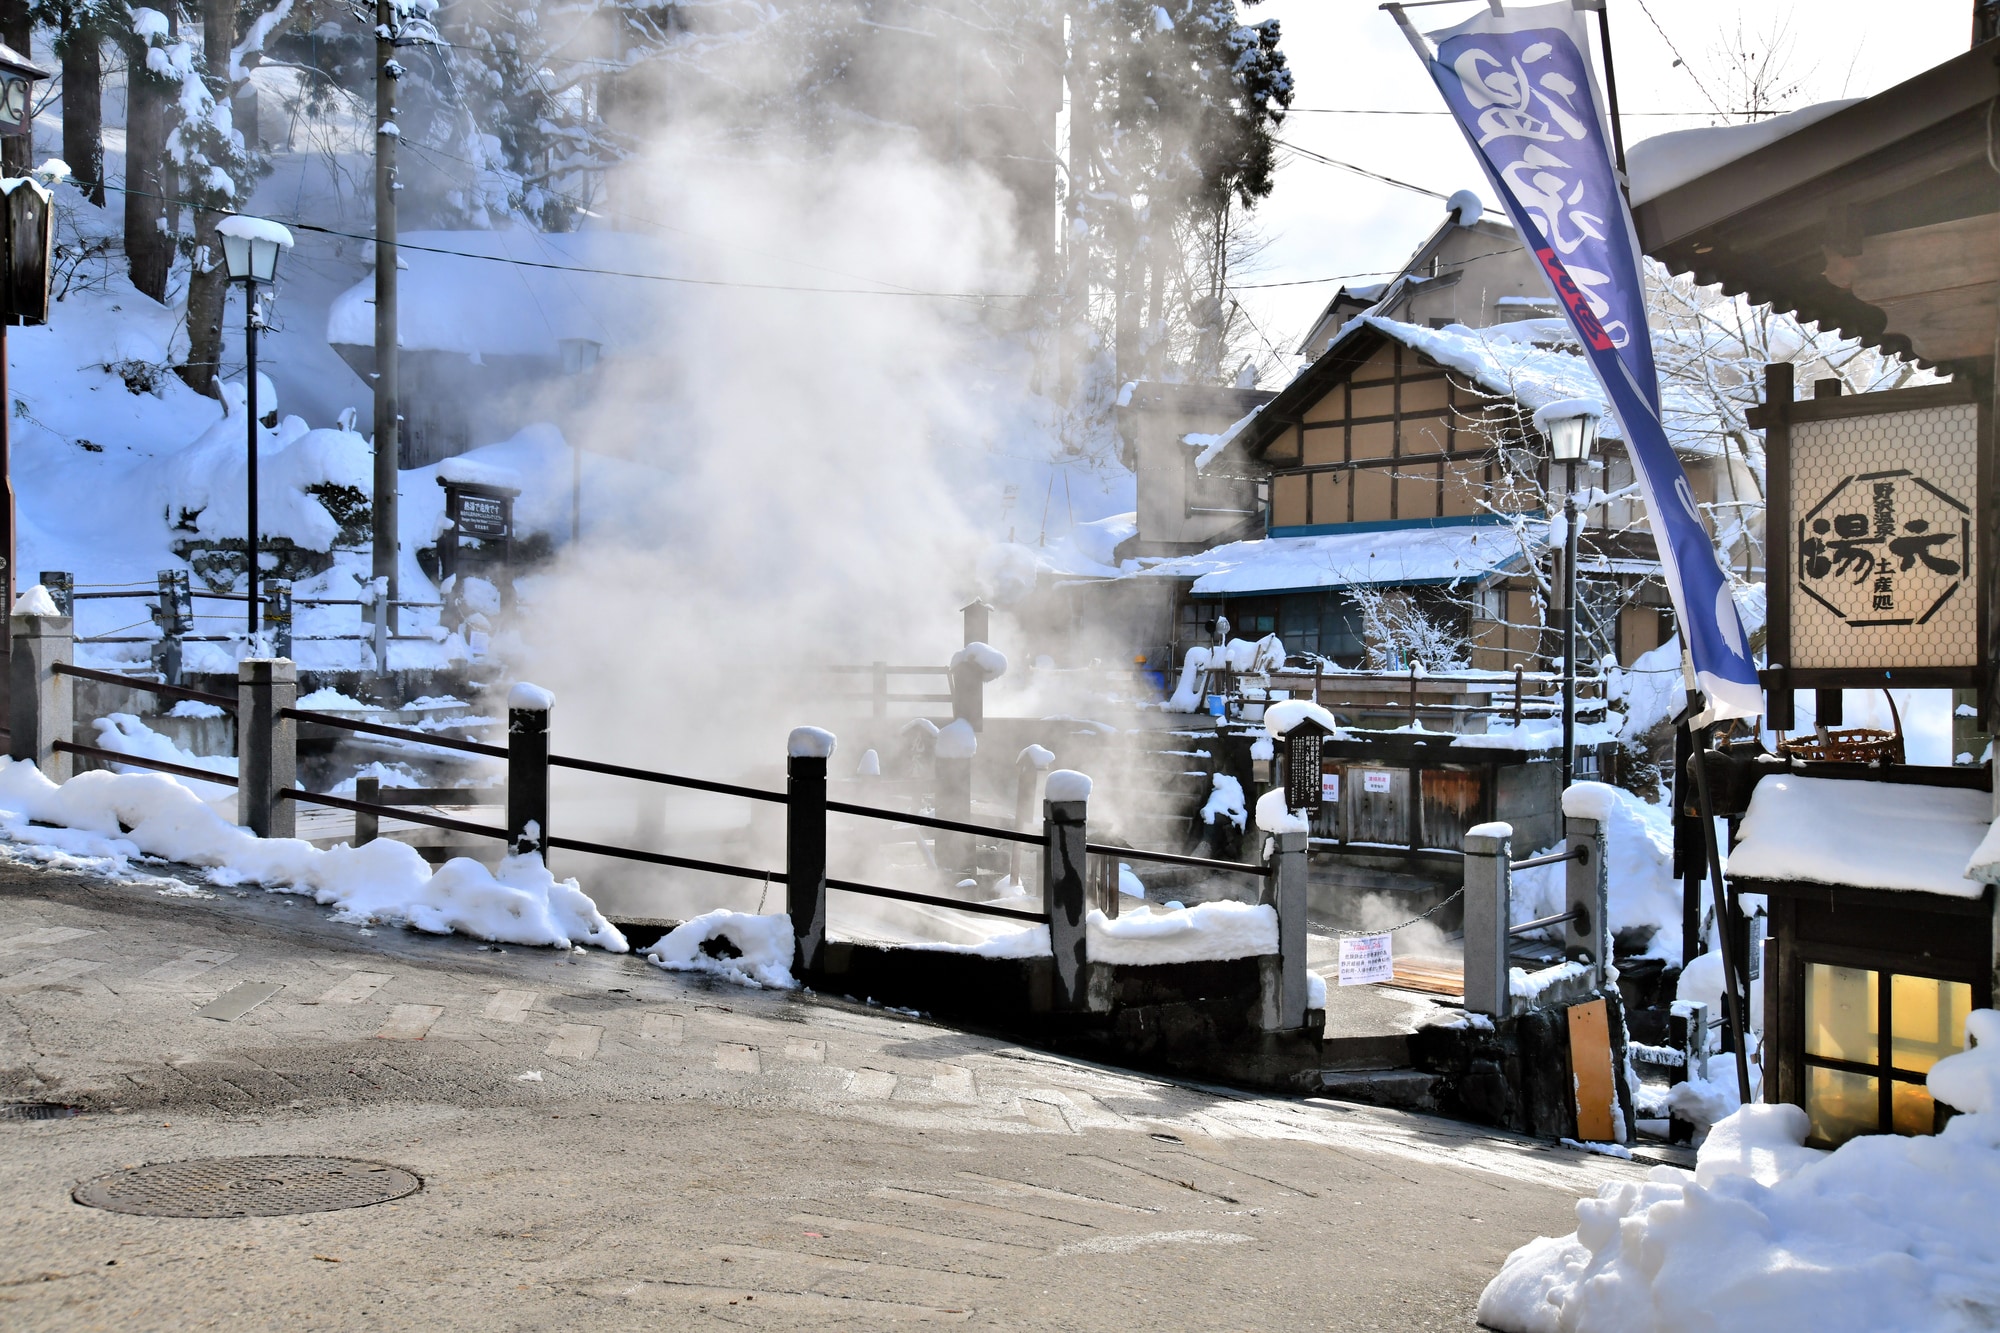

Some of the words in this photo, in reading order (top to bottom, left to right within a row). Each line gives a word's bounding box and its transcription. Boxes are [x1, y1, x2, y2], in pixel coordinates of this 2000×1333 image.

[1872, 482, 1896, 538] 野沢温泉
[1801, 513, 1961, 585] 湯元
[1872, 557, 1896, 611] 土産処
